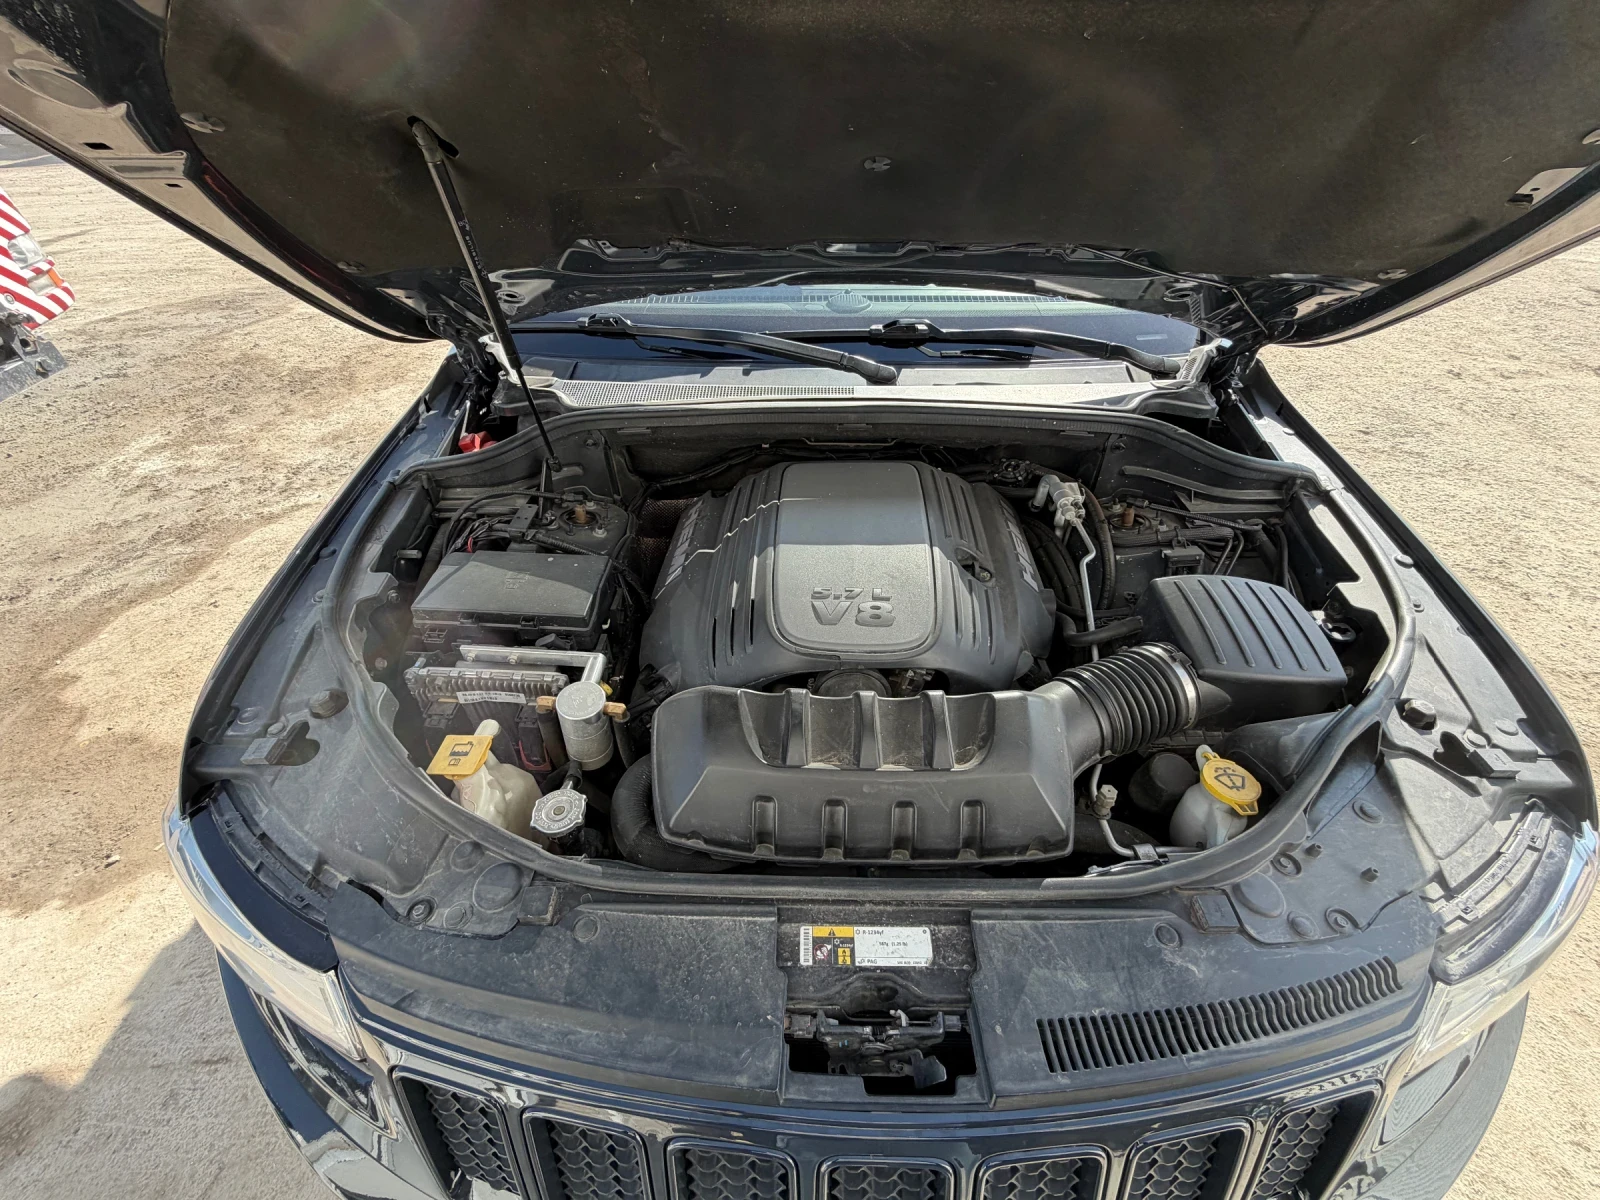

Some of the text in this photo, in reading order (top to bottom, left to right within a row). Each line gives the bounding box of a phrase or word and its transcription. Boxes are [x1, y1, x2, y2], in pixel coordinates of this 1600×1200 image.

[465, 235, 481, 270] STABILUS
[665, 499, 703, 586] HEMI
[1000, 499, 1039, 592] HEMI
[811, 587, 864, 600] 5.7
[811, 601, 896, 627] V8
